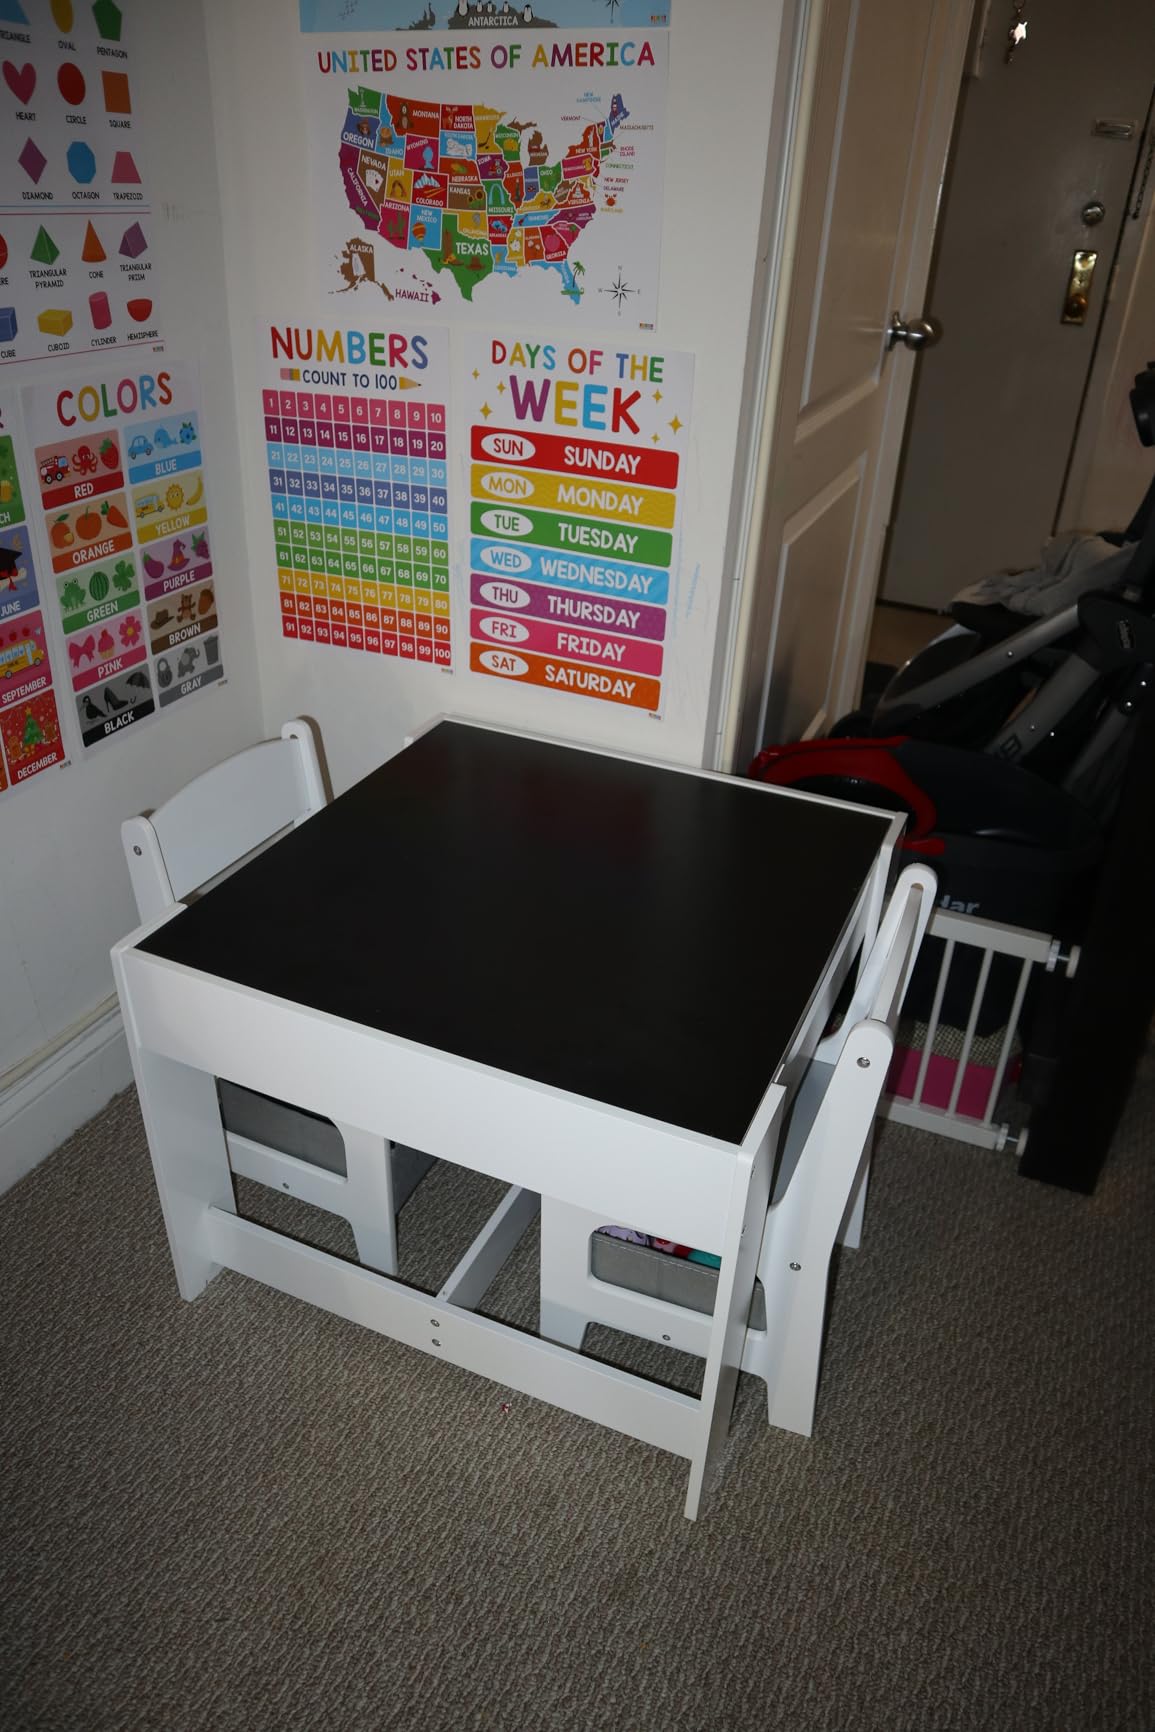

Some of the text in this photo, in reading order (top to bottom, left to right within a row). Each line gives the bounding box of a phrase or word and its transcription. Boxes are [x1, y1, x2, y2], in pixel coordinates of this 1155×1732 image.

[468, 16, 518, 26] ANTARCTICA
[58, 40, 76, 51] OVAL
[96, 46, 128, 59] PENTAGON
[318, 42, 655, 74] UNITED STATES OF AMERICA
[16, 112, 36, 121] HEART
[66, 115, 87, 125] CIRCLE
[412, 110, 440, 119] MONTANA
[109, 120, 132, 129] SQUARE
[343, 131, 374, 148] OREGON
[362, 154, 386, 170] NEVADA
[347, 168, 368, 206] CALIFORNIA
[450, 187, 471, 195] KANSAS
[22, 192, 54, 200] DIAMOND
[72, 192, 100, 200] OCTAGON
[113, 192, 144, 201] TRAPEZOID
[416, 198, 444, 206] COLORADO
[384, 202, 410, 212] ARIZONA
[416, 215, 438, 224] MEXICO
[350, 244, 374, 254] ALASKA
[456, 242, 488, 256] TEXAS
[29, 268, 67, 278] TRIANGULAR
[88, 271, 104, 279] CONE
[120, 263, 152, 272] TRIANGULAR
[35, 280, 64, 289] PYRAMID
[128, 274, 146, 282] PRISM
[396, 288, 429, 302] HAWAII
[48, 342, 70, 352] CUBOID
[91, 336, 117, 347] CYLINDER
[270, 326, 428, 369] NUMBERS
[0, 349, 16, 358] CUBE
[492, 340, 664, 383] DAYS OF THE
[302, 370, 397, 390] COUNT TO 100
[56, 372, 173, 427] COLORS
[509, 374, 642, 434] WEEK
[269, 398, 442, 423] 1 2 3 4 5 6 7 8 9 10
[270, 425, 443, 451] 11 12 13 14 15 16 17 18 19 20
[494, 438, 641, 476] SUN SUNDAY
[155, 459, 178, 476] BLUE
[74, 482, 94, 499] RED
[273, 477, 445, 506] 31 32 33 34 35 36 37 38 39 40
[488, 476, 644, 516] MON MONDAY
[156, 515, 190, 535] YELLOW
[494, 514, 638, 554] TUE TUESDAY
[72, 539, 115, 564] ORANGE
[278, 527, 446, 559] 51 52 53 54 55 56 57 58 59 60
[490, 550, 653, 594] WED WEDNESDAY
[163, 571, 196, 592] PURPLE
[0, 601, 20, 616] JUNE
[86, 601, 118, 622] GREEN
[284, 598, 448, 634] 81 82 83 84 85 86 87 88 89 90
[492, 586, 640, 629] THU THURSDAY
[168, 622, 201, 645] BROWN
[286, 622, 451, 659] 91 92 93 94 95 96 97 98 99 100
[492, 620, 626, 662] FRI FRIDAY
[98, 658, 123, 678] PINK
[491, 655, 636, 698] SAT SATURDAY
[2, 676, 46, 704] SEPTEMBER
[180, 676, 202, 694] GRAY
[104, 711, 134, 734] BLACK
[17, 752, 57, 780] DECEMBER
